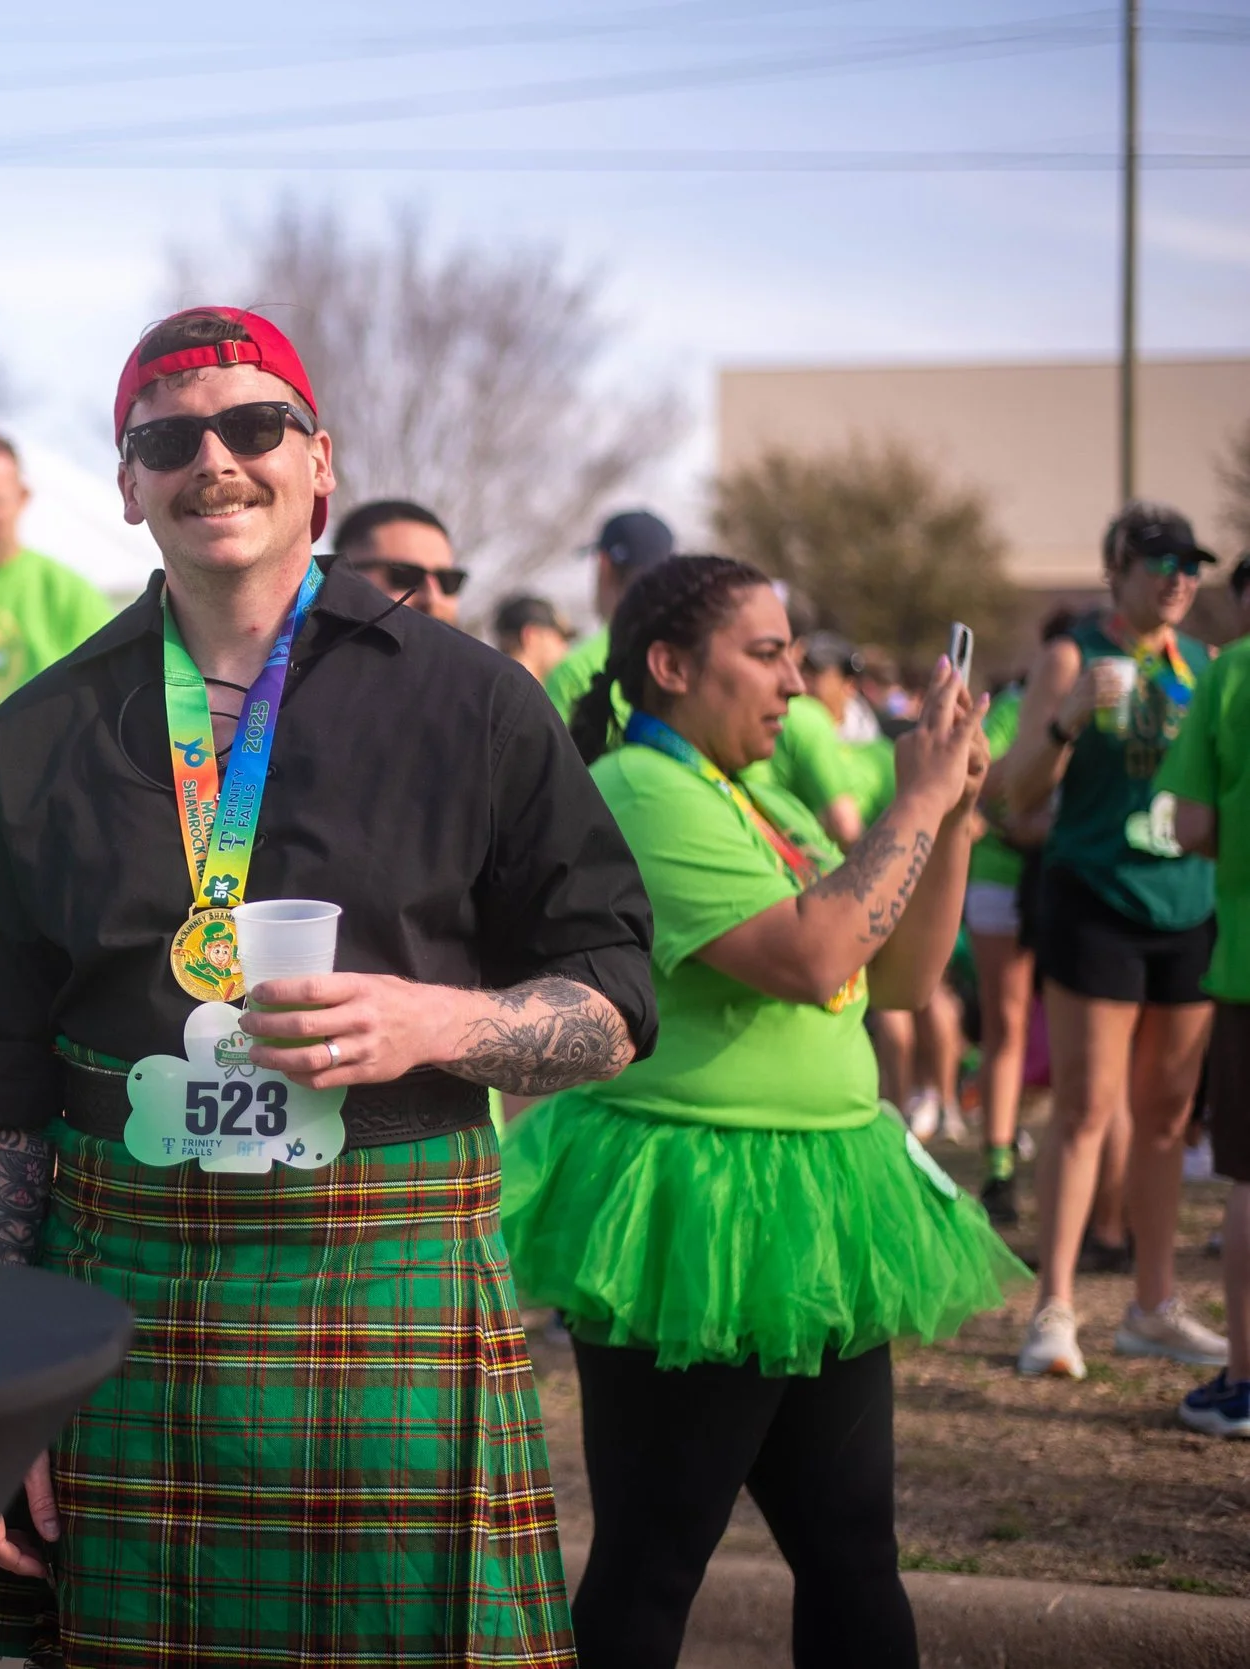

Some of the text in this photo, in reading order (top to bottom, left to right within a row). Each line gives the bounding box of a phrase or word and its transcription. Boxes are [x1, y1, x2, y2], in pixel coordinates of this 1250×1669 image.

[241, 700, 270, 753] 2025
[182, 779, 208, 856] SHAMROCK
[223, 769, 244, 825] TRINITY
[238, 784, 257, 828] FALLS
[213, 880, 230, 899] 5K
[184, 1080, 288, 1137] 523
[181, 1138, 223, 1148] TRINITY
[181, 1148, 213, 1157] FALLS
